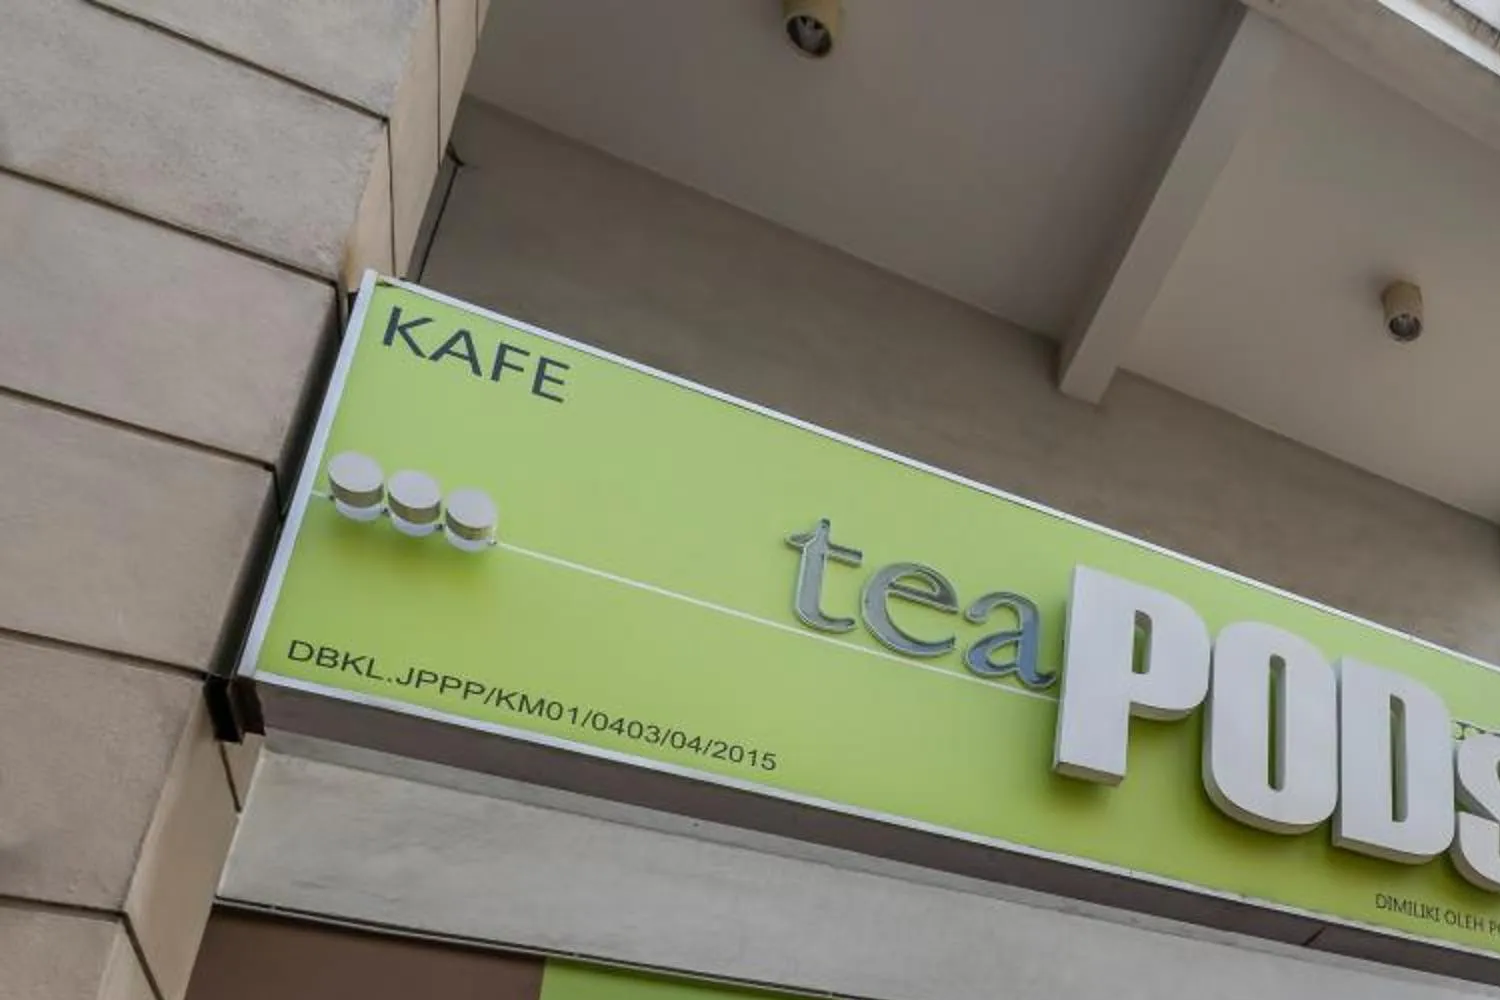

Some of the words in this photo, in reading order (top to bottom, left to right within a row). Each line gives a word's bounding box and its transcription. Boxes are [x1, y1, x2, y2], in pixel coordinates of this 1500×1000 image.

[381, 307, 571, 404] KAFE
[784, 518, 1056, 688] tea
[286, 640, 777, 773] DBKL.JPPP/KM01/0403/04/2015
[1375, 893, 1440, 923] DIMILIKI
[1443, 910, 1485, 933] OLEH
